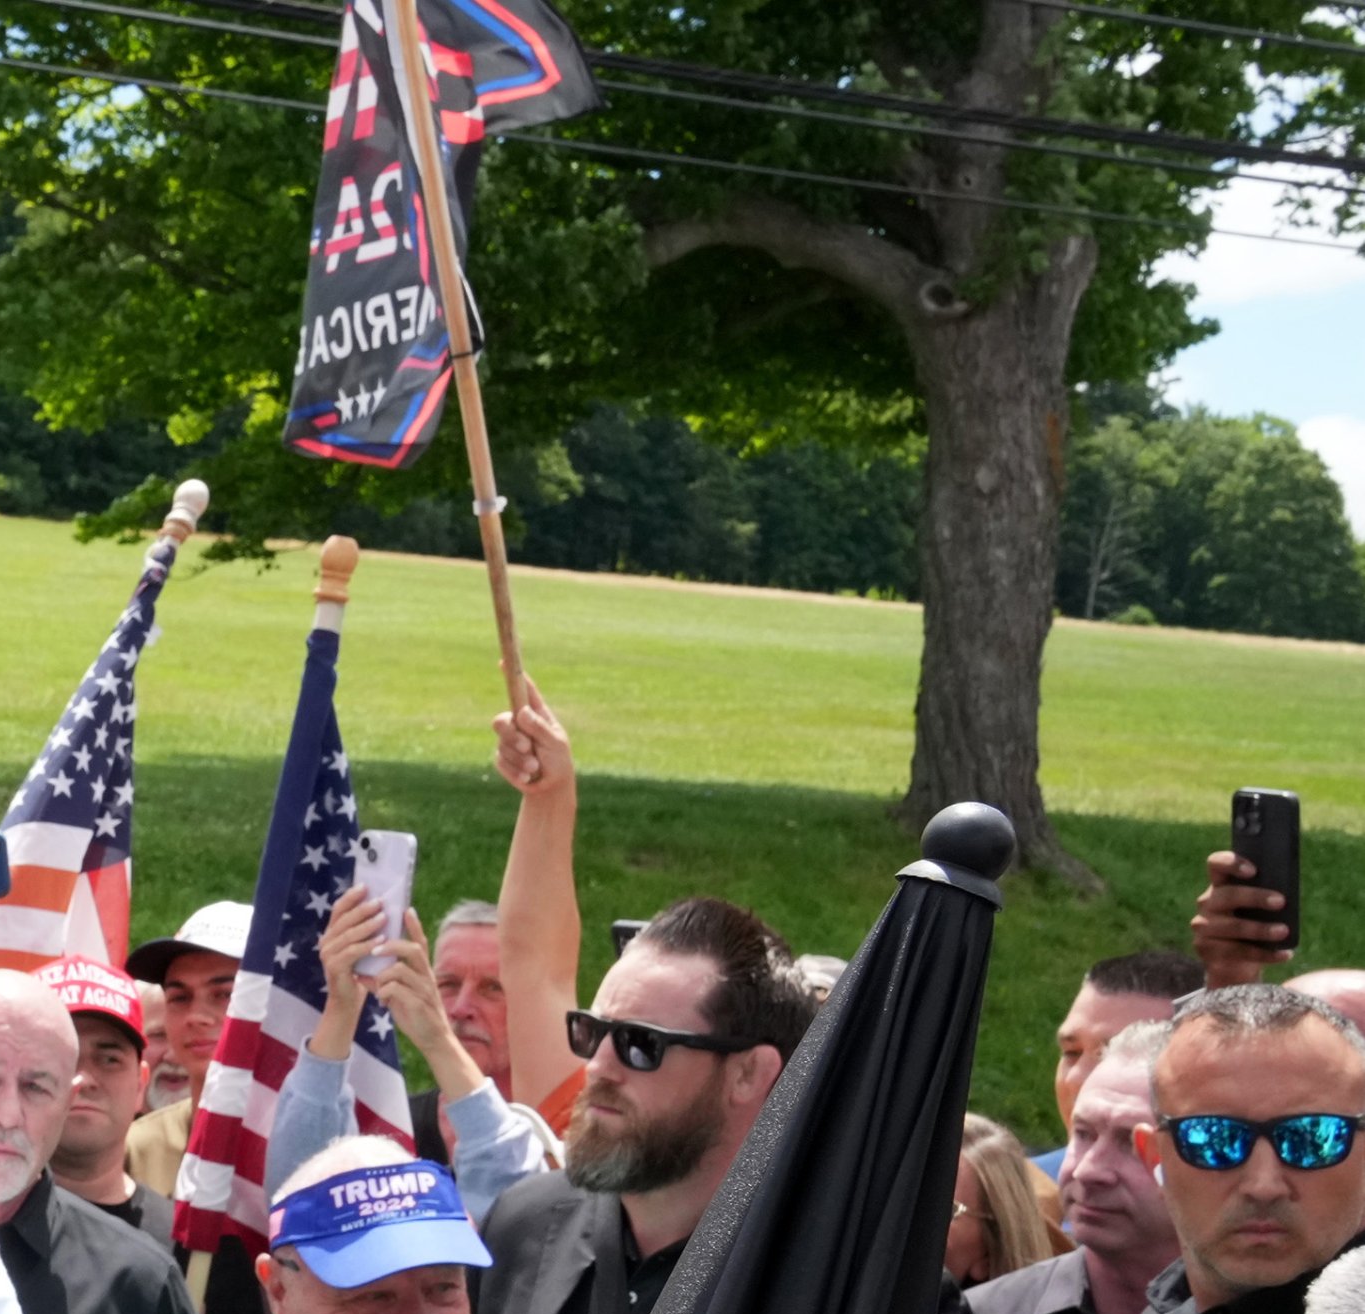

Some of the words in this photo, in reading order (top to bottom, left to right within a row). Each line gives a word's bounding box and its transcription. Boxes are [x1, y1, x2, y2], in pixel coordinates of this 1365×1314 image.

[66, 961, 137, 1000] AMERICA
[329, 1172, 437, 1208] TRUMP
[358, 1197, 417, 1217] 2024
